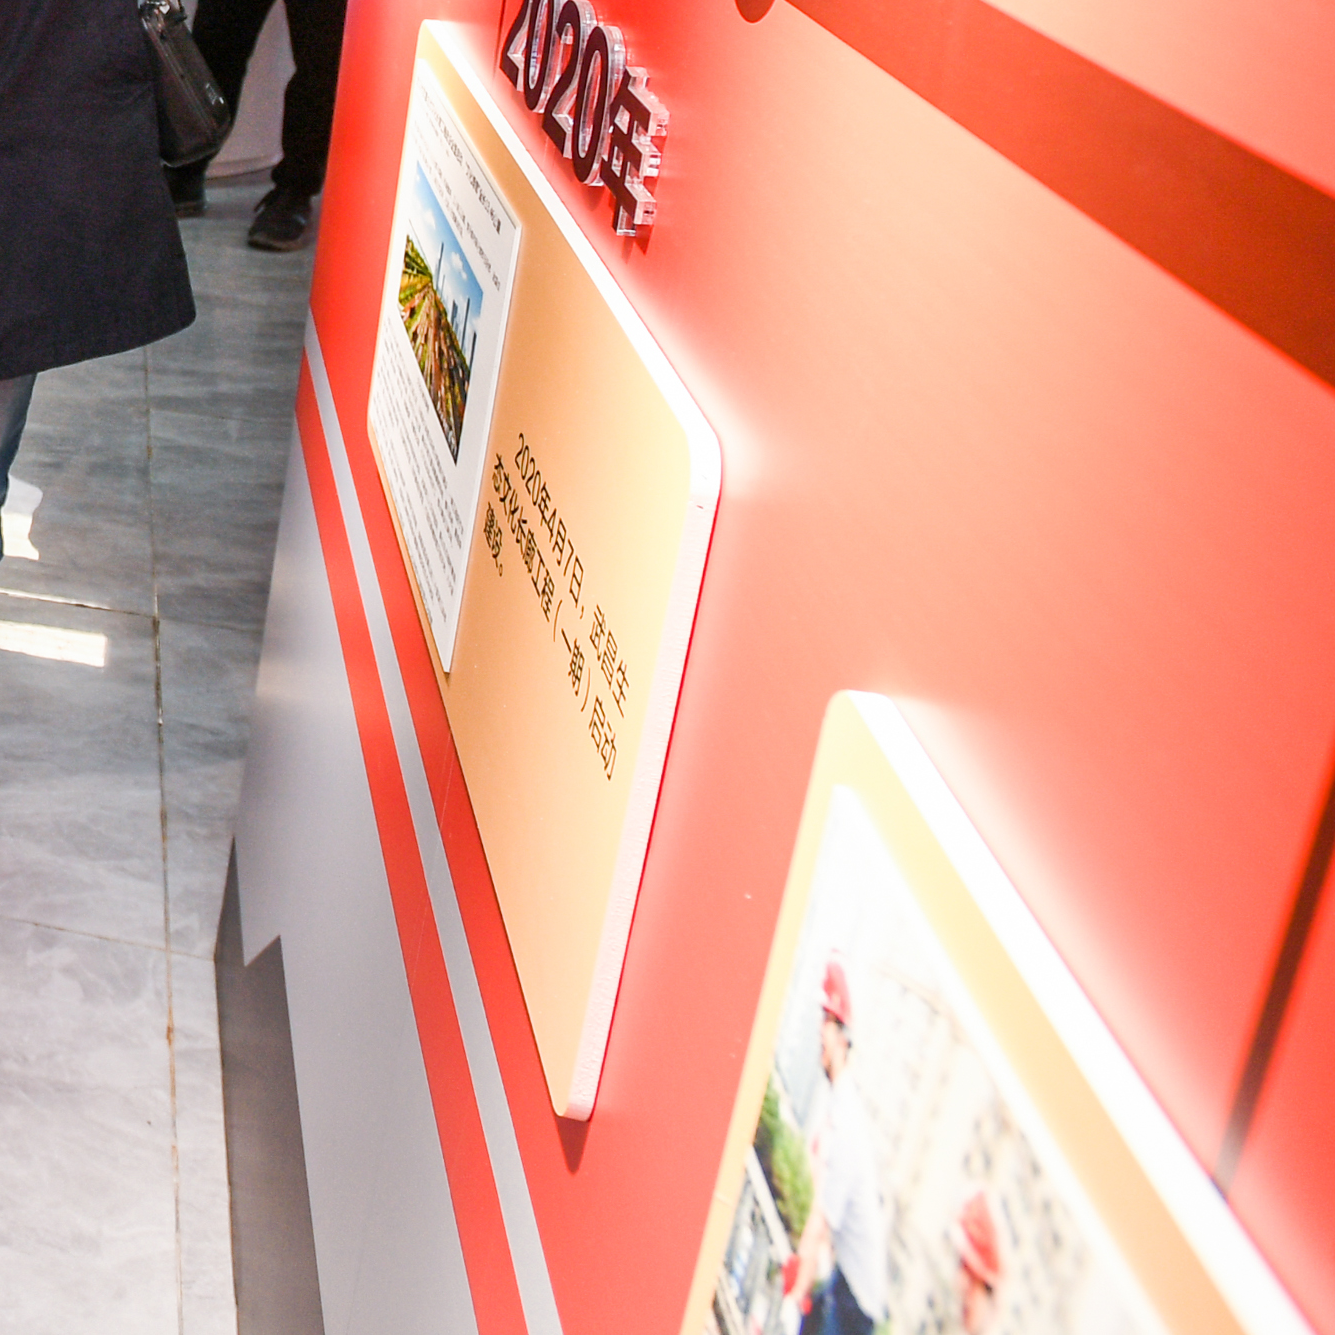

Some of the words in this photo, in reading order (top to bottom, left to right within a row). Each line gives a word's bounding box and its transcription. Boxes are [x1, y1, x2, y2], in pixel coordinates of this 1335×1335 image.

[483, 501, 504, 577] 建设。
[514, 432, 630, 718] 2020年4月7日，武昌生
